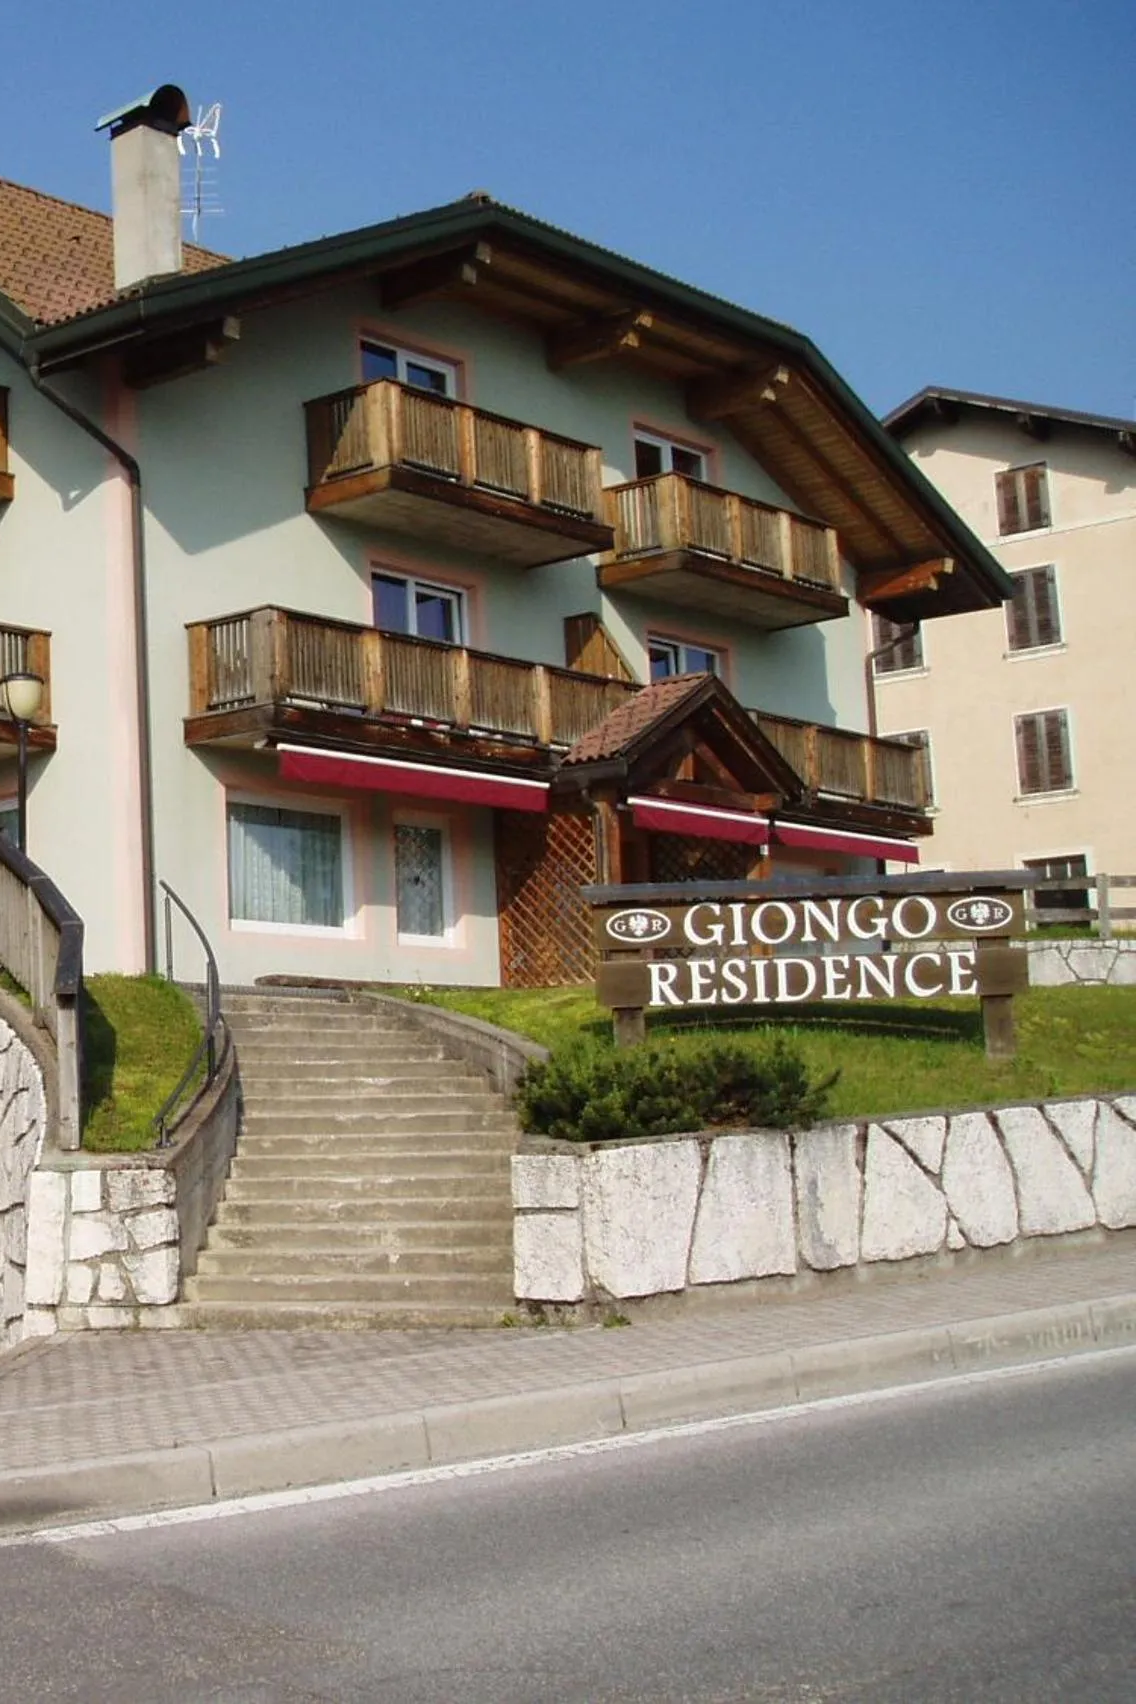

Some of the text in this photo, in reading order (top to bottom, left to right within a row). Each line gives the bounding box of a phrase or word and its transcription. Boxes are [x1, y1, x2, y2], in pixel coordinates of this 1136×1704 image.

[614, 919, 662, 932] G R
[683, 896, 937, 945] GIONGO
[955, 907, 1004, 920] G R
[648, 951, 978, 1006] RESIDENCE
